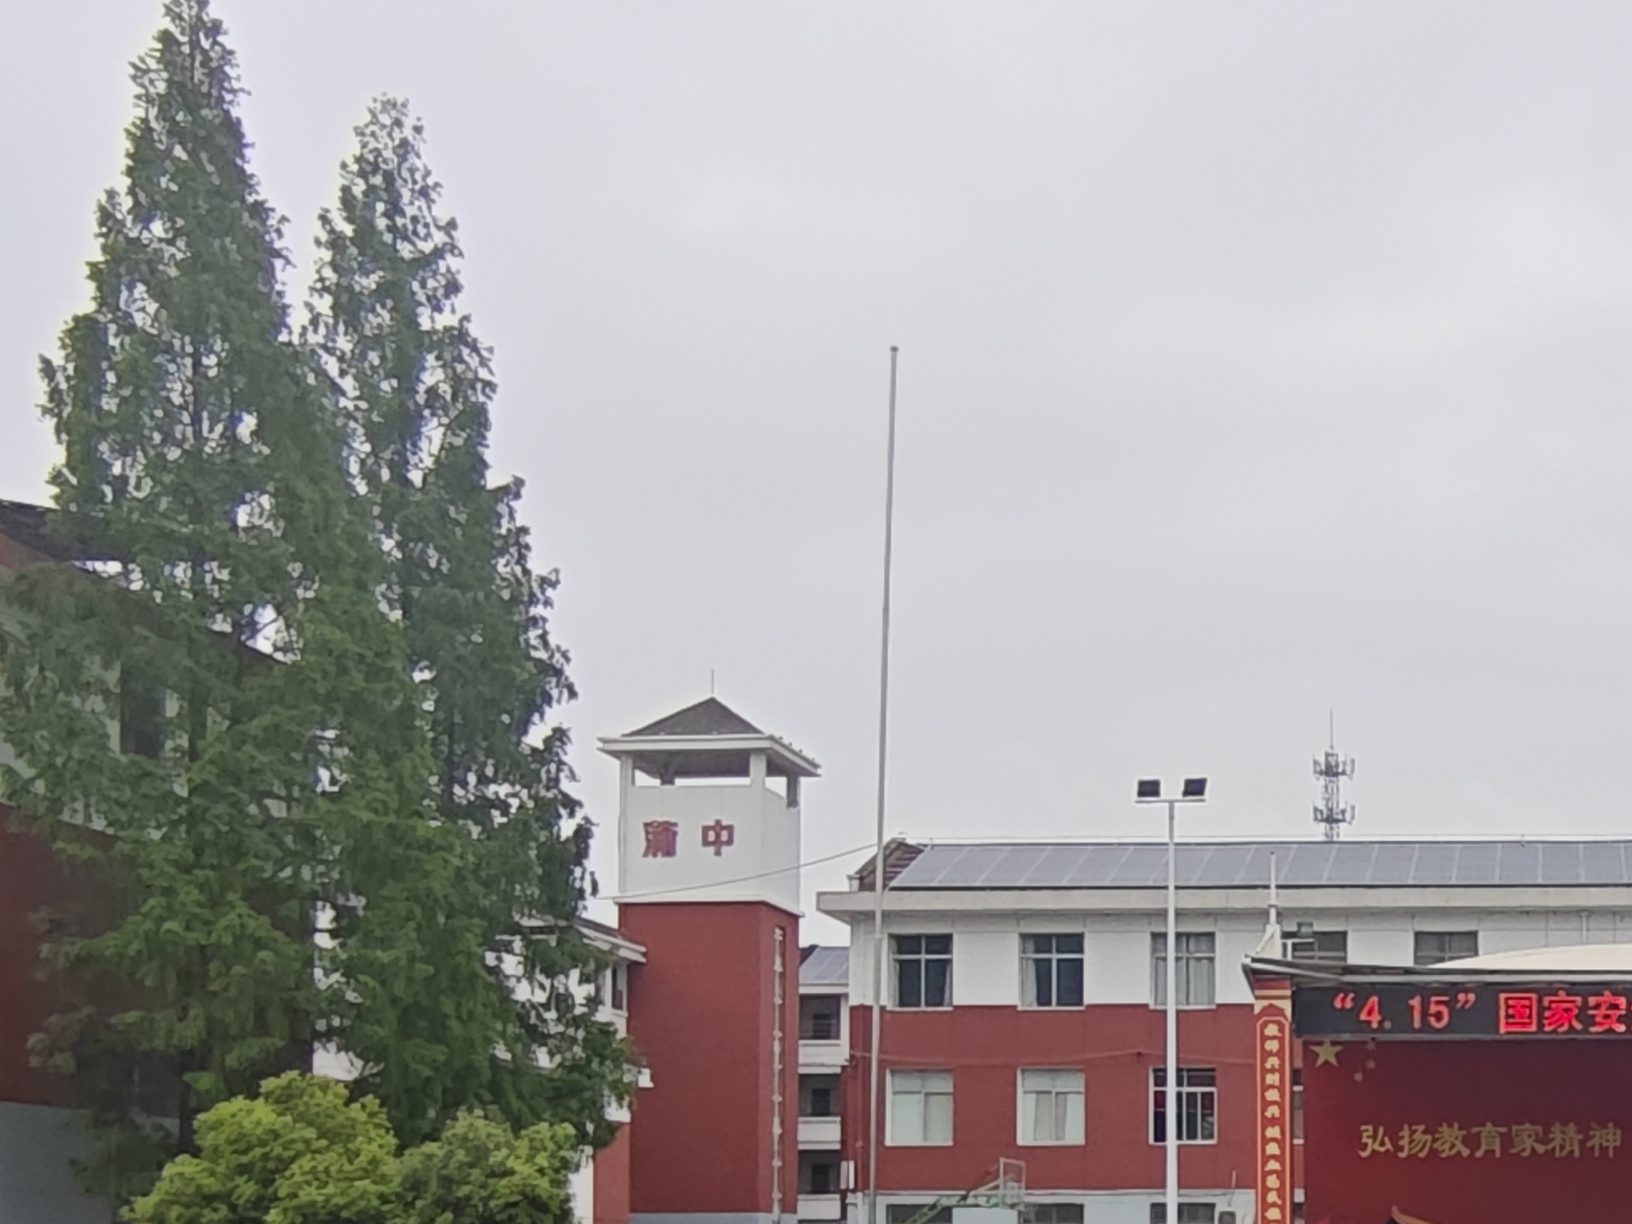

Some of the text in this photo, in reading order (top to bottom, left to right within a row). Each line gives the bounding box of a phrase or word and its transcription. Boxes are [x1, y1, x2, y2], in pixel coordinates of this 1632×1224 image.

[1358, 1121, 1622, 1158] 弘扬教育家精神
